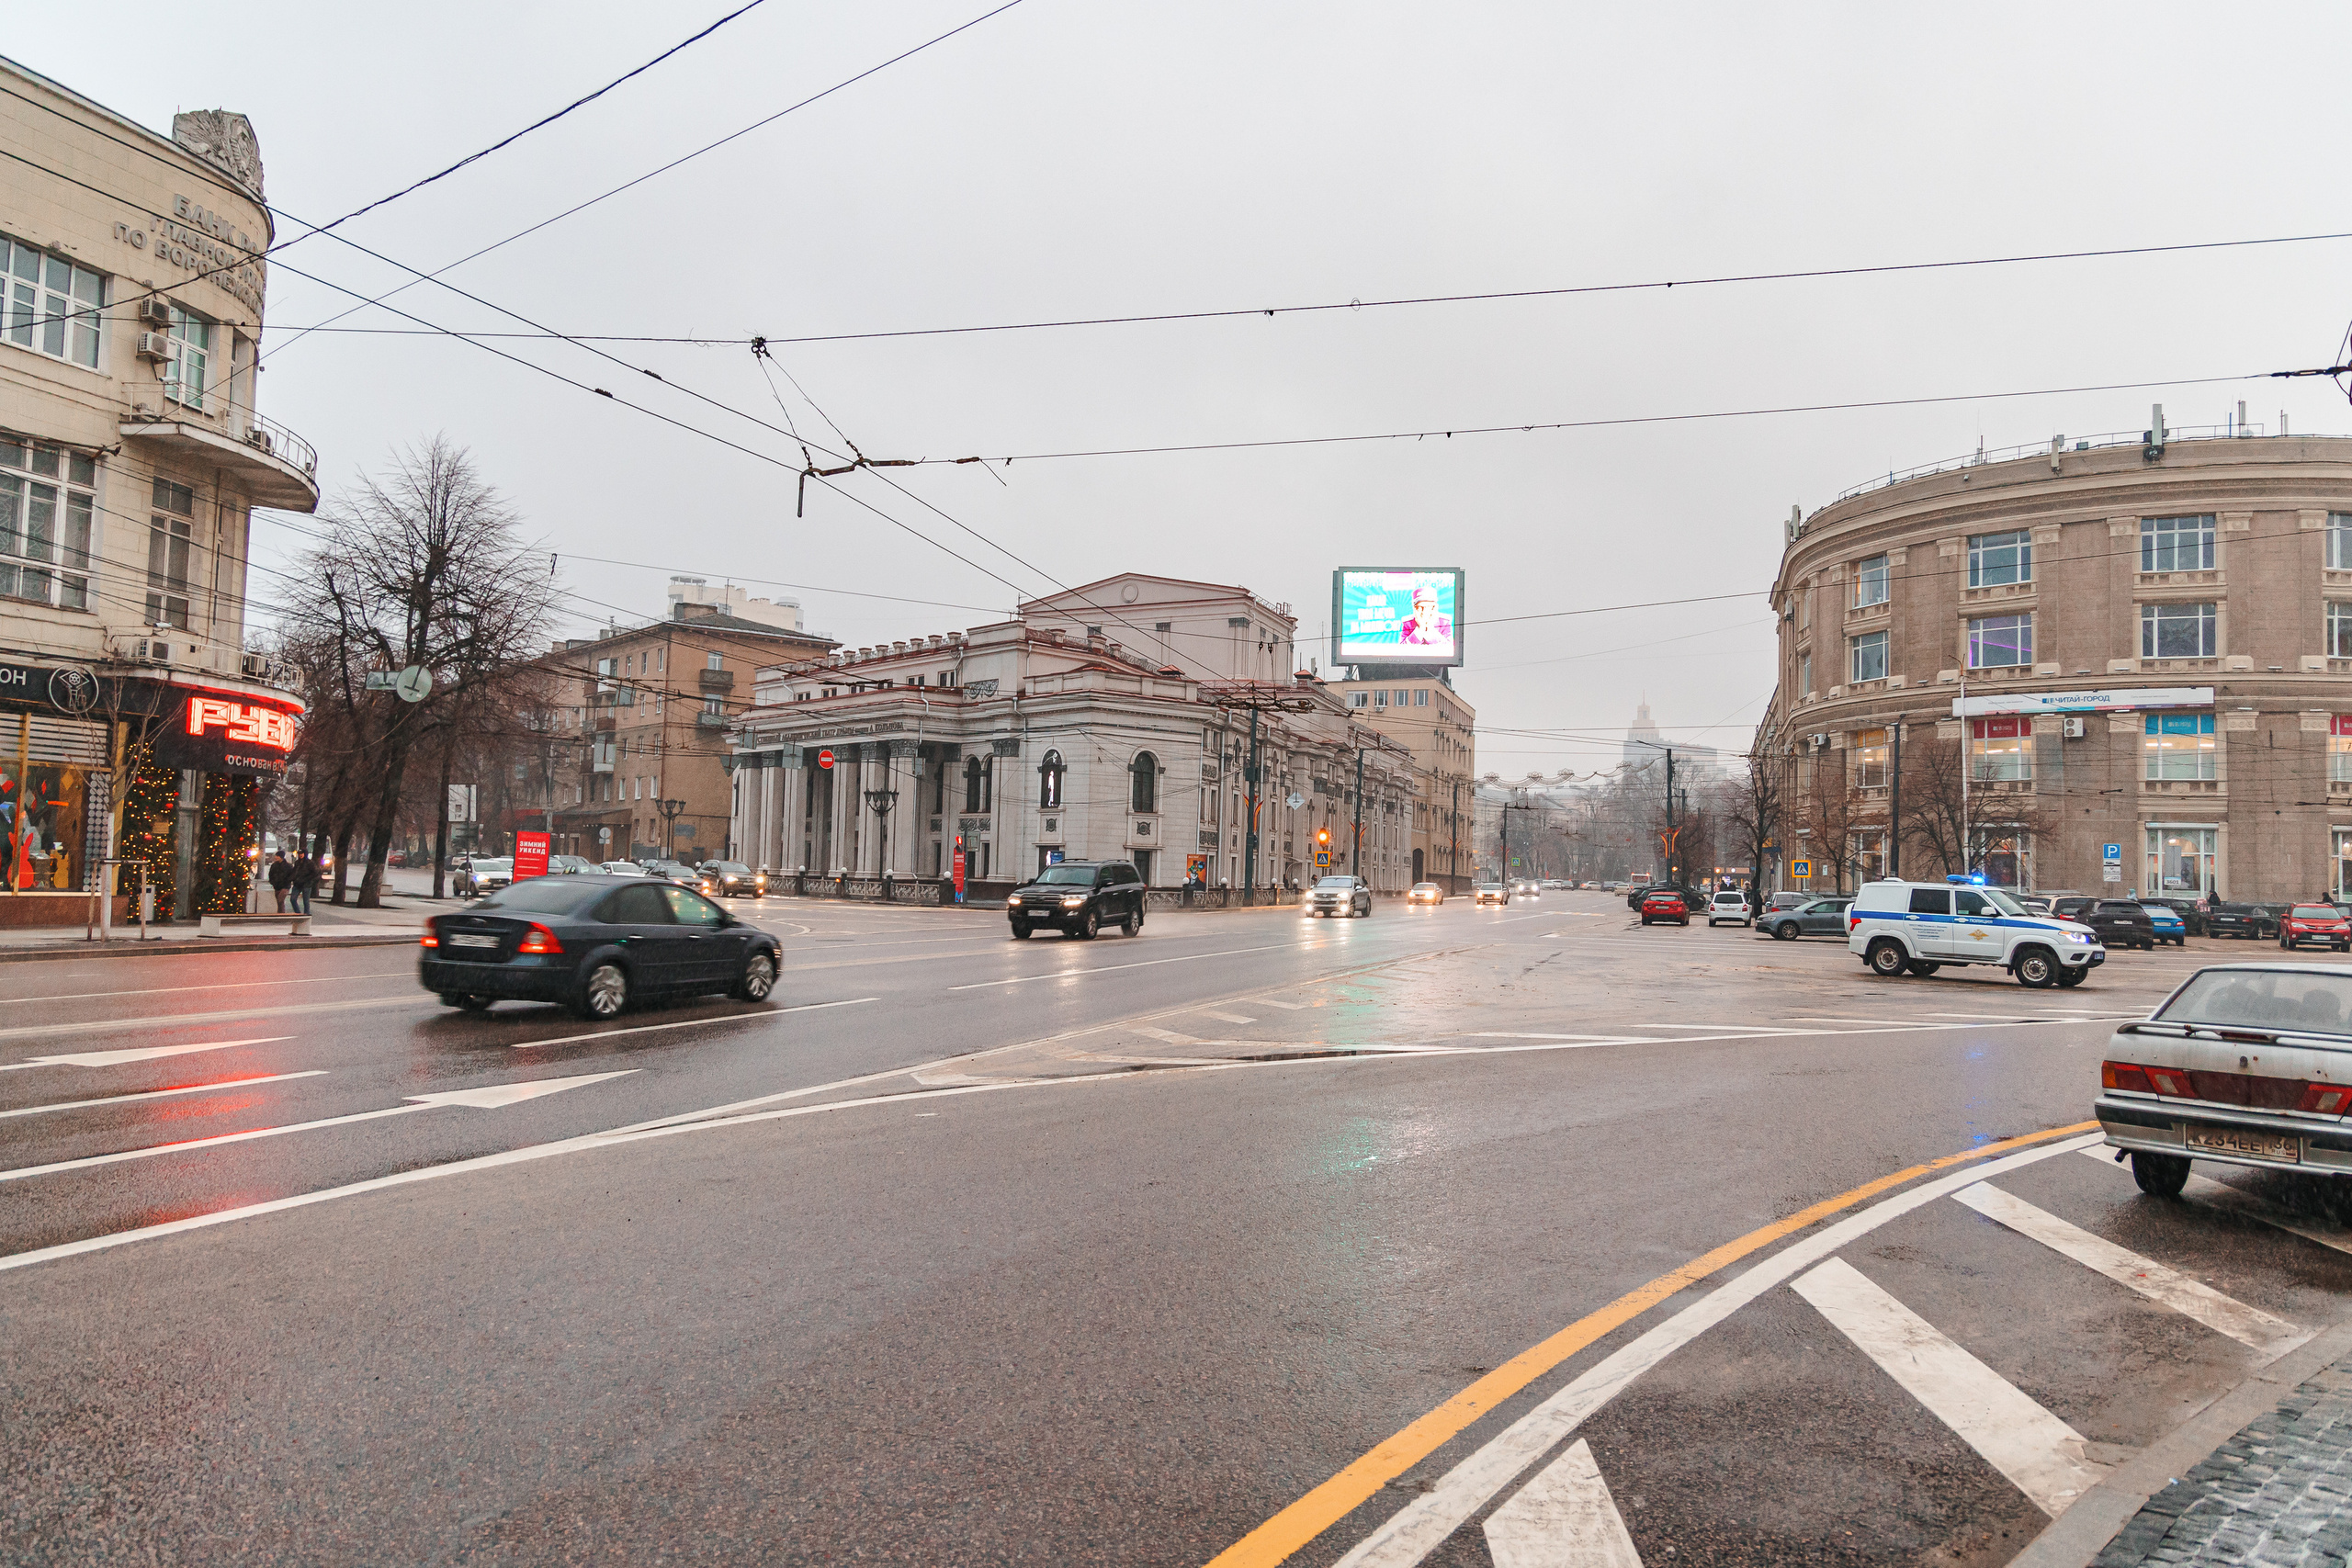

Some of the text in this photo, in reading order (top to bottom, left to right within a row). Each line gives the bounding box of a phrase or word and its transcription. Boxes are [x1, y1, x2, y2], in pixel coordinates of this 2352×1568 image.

[174, 193, 235, 244] БАНК
[114, 220, 147, 249] ПО
[150, 215, 236, 274] ГЛАВНОЕ
[2055, 694, 2110, 704] ЧИТАЙ-ГОРОД
[519, 847, 546, 855] УИКЕНД
